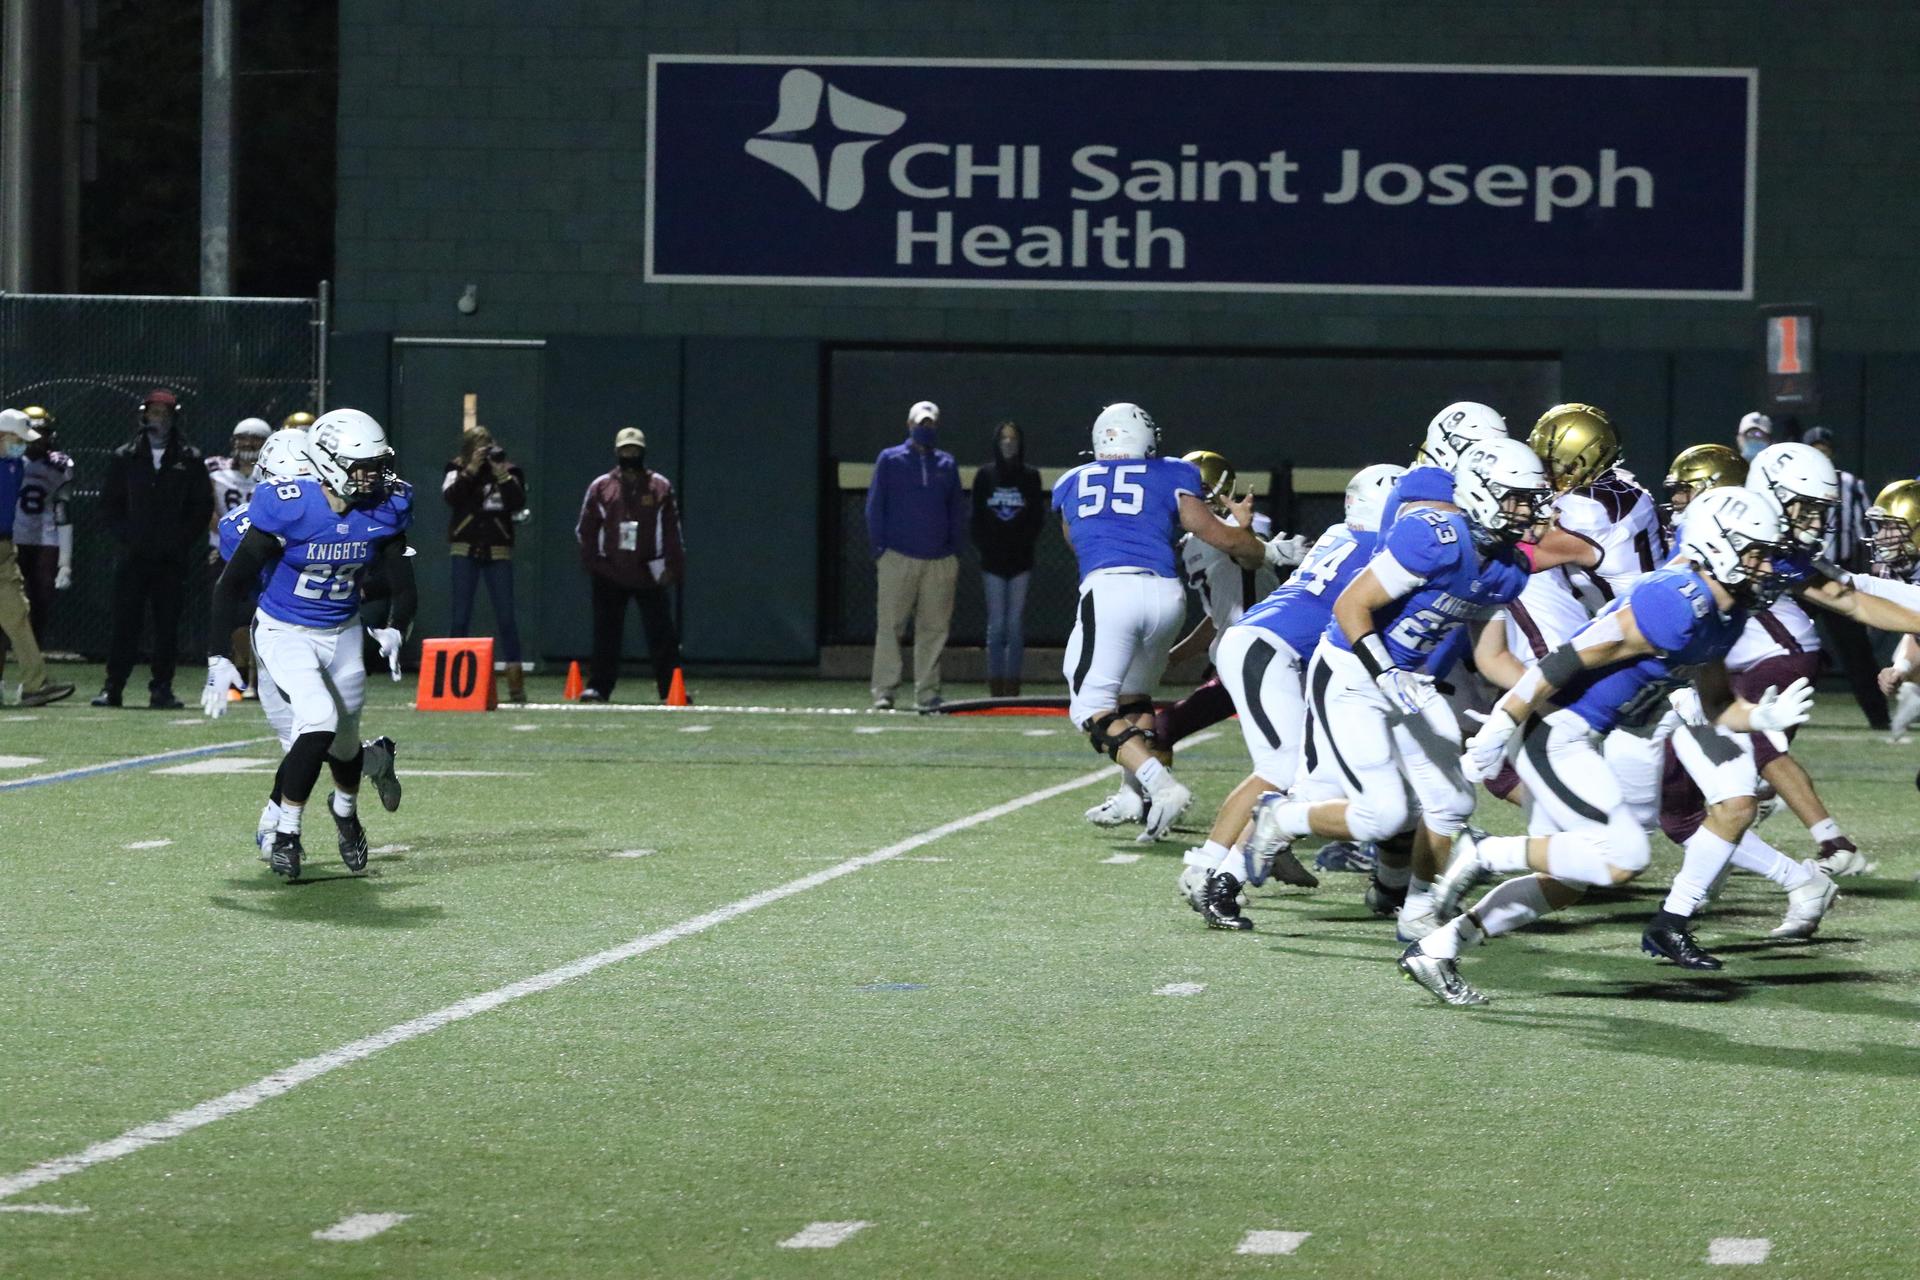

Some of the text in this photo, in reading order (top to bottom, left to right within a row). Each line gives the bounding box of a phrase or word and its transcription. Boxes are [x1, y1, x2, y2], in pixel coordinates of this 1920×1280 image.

[888, 143, 1655, 222] CHI Saint Joseph
[896, 209, 1186, 268] Health
[1078, 464, 1147, 518] 55
[306, 541, 368, 560] KNIGHTS
[1420, 511, 1459, 545] 23
[432, 650, 478, 698] 10
